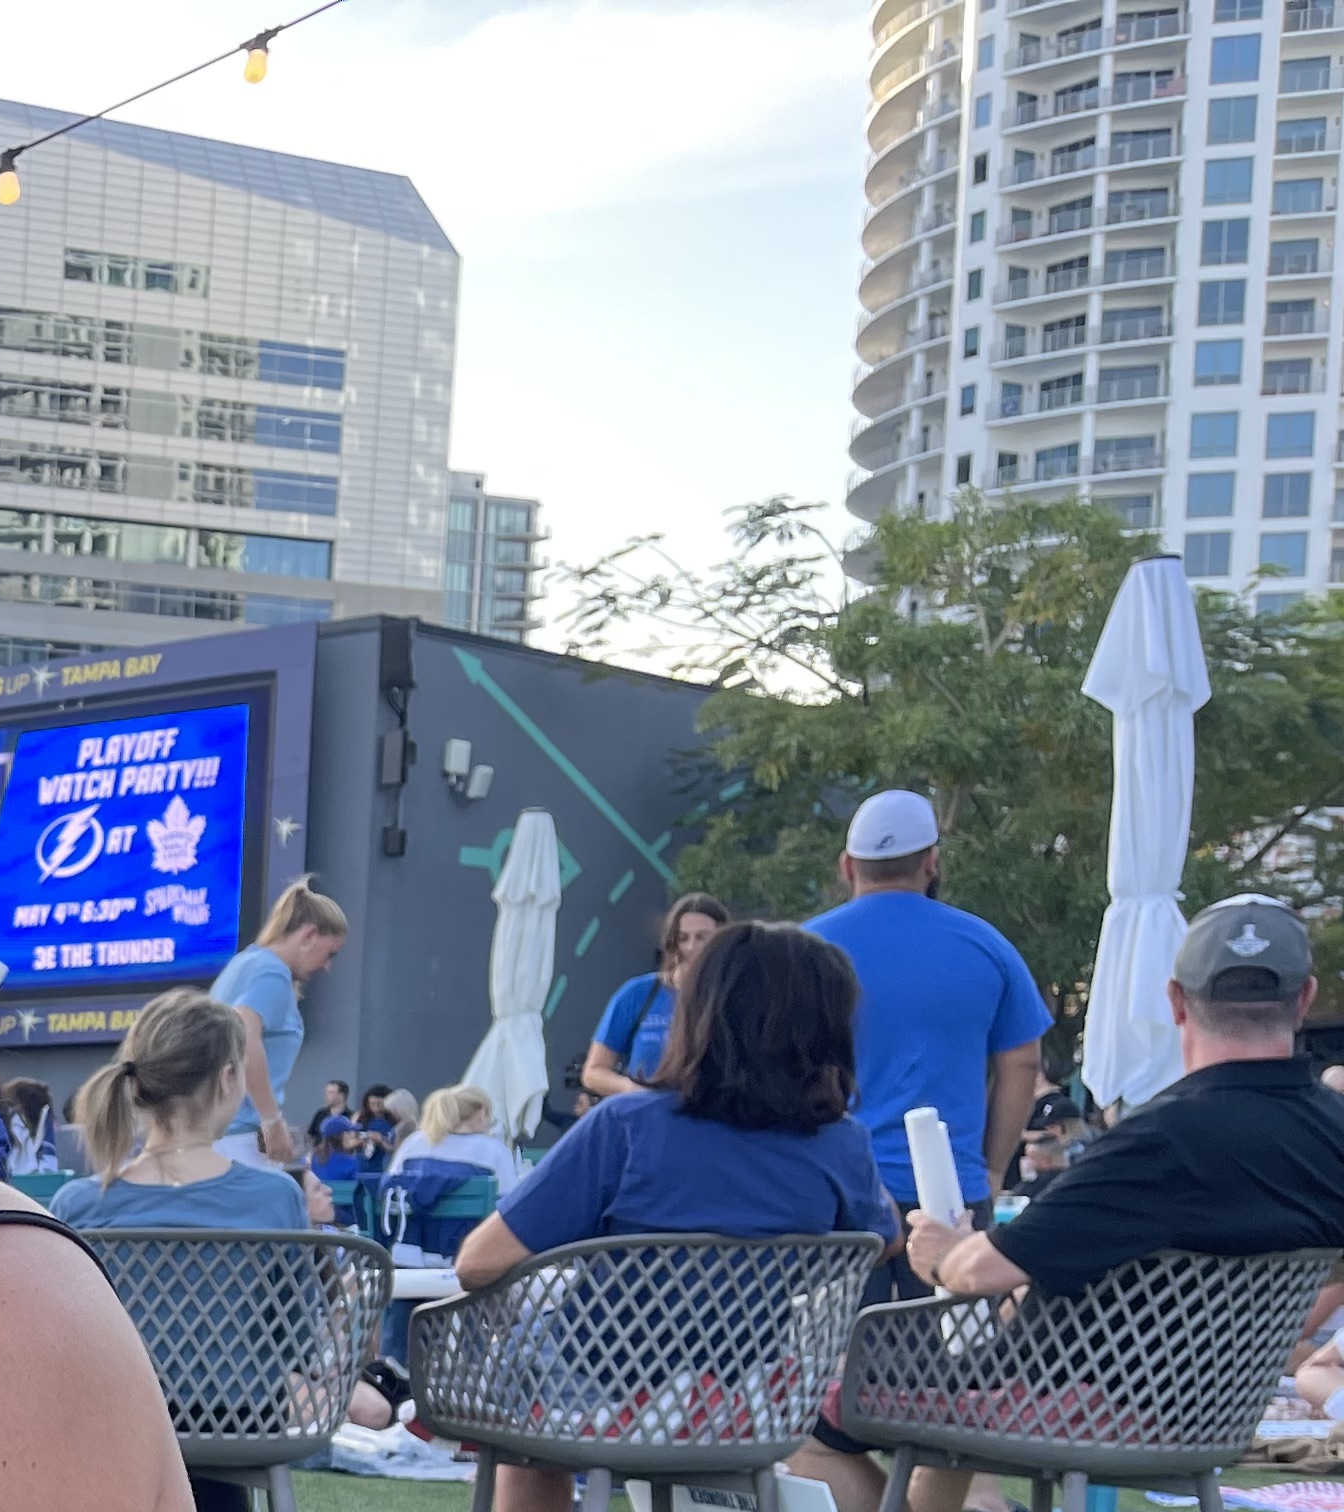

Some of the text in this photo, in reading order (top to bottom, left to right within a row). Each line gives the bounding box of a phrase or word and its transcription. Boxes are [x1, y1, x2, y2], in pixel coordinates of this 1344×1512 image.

[5, 672, 30, 695] UP
[62, 660, 120, 686] TAMPA
[124, 653, 161, 678] BAY
[77, 728, 179, 767] PLAYOFF
[38, 756, 221, 806] WATCH PARTY!!!
[106, 824, 138, 855] AT
[14, 904, 52, 928] MAY
[59, 942, 93, 968] THE
[97, 937, 175, 966] THUNDER
[47, 1011, 106, 1033] TAMPA
